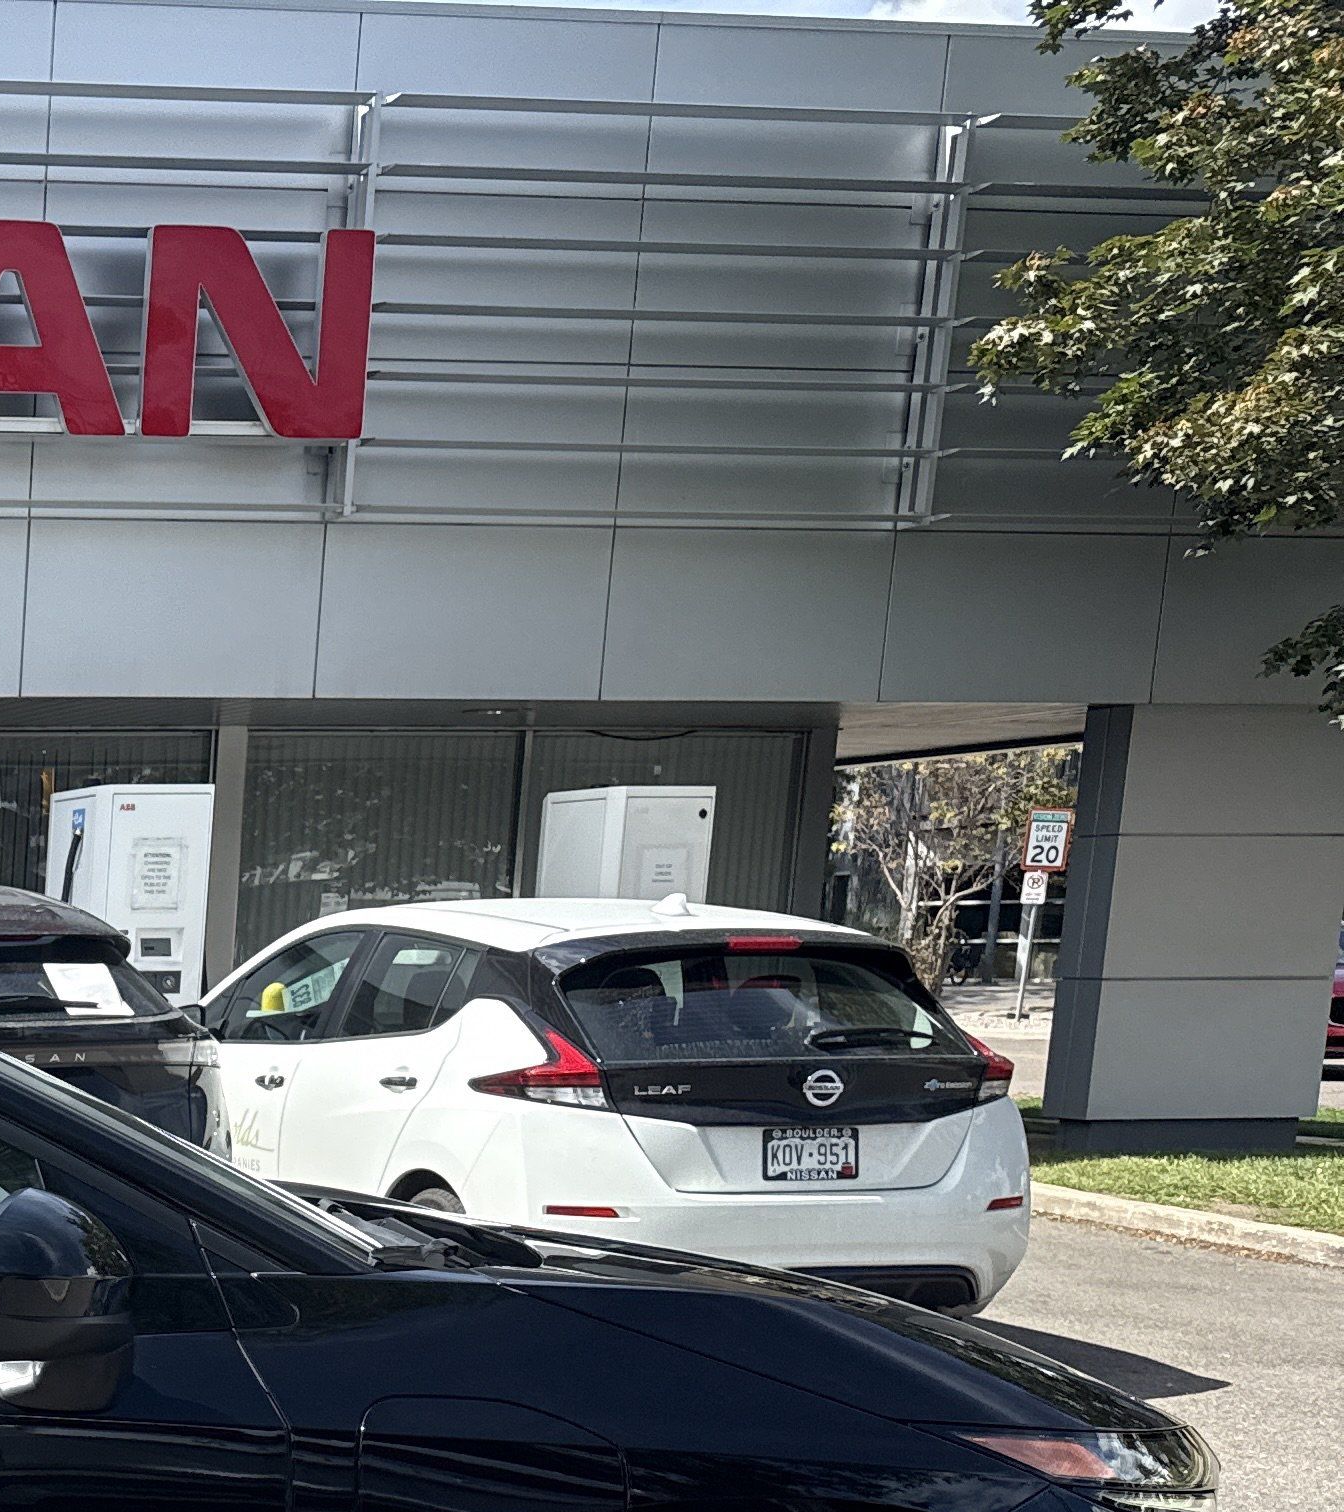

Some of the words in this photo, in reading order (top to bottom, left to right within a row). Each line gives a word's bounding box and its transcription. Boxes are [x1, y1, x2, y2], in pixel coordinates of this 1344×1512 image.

[1034, 824, 1063, 833] SPEED
[1036, 835, 1059, 843] LIMIT
[1030, 845, 1059, 863] 20
[634, 1085, 691, 1095] LEAF
[786, 1128, 837, 1138] BOULDER
[786, 1170, 837, 1180] NISSAN
